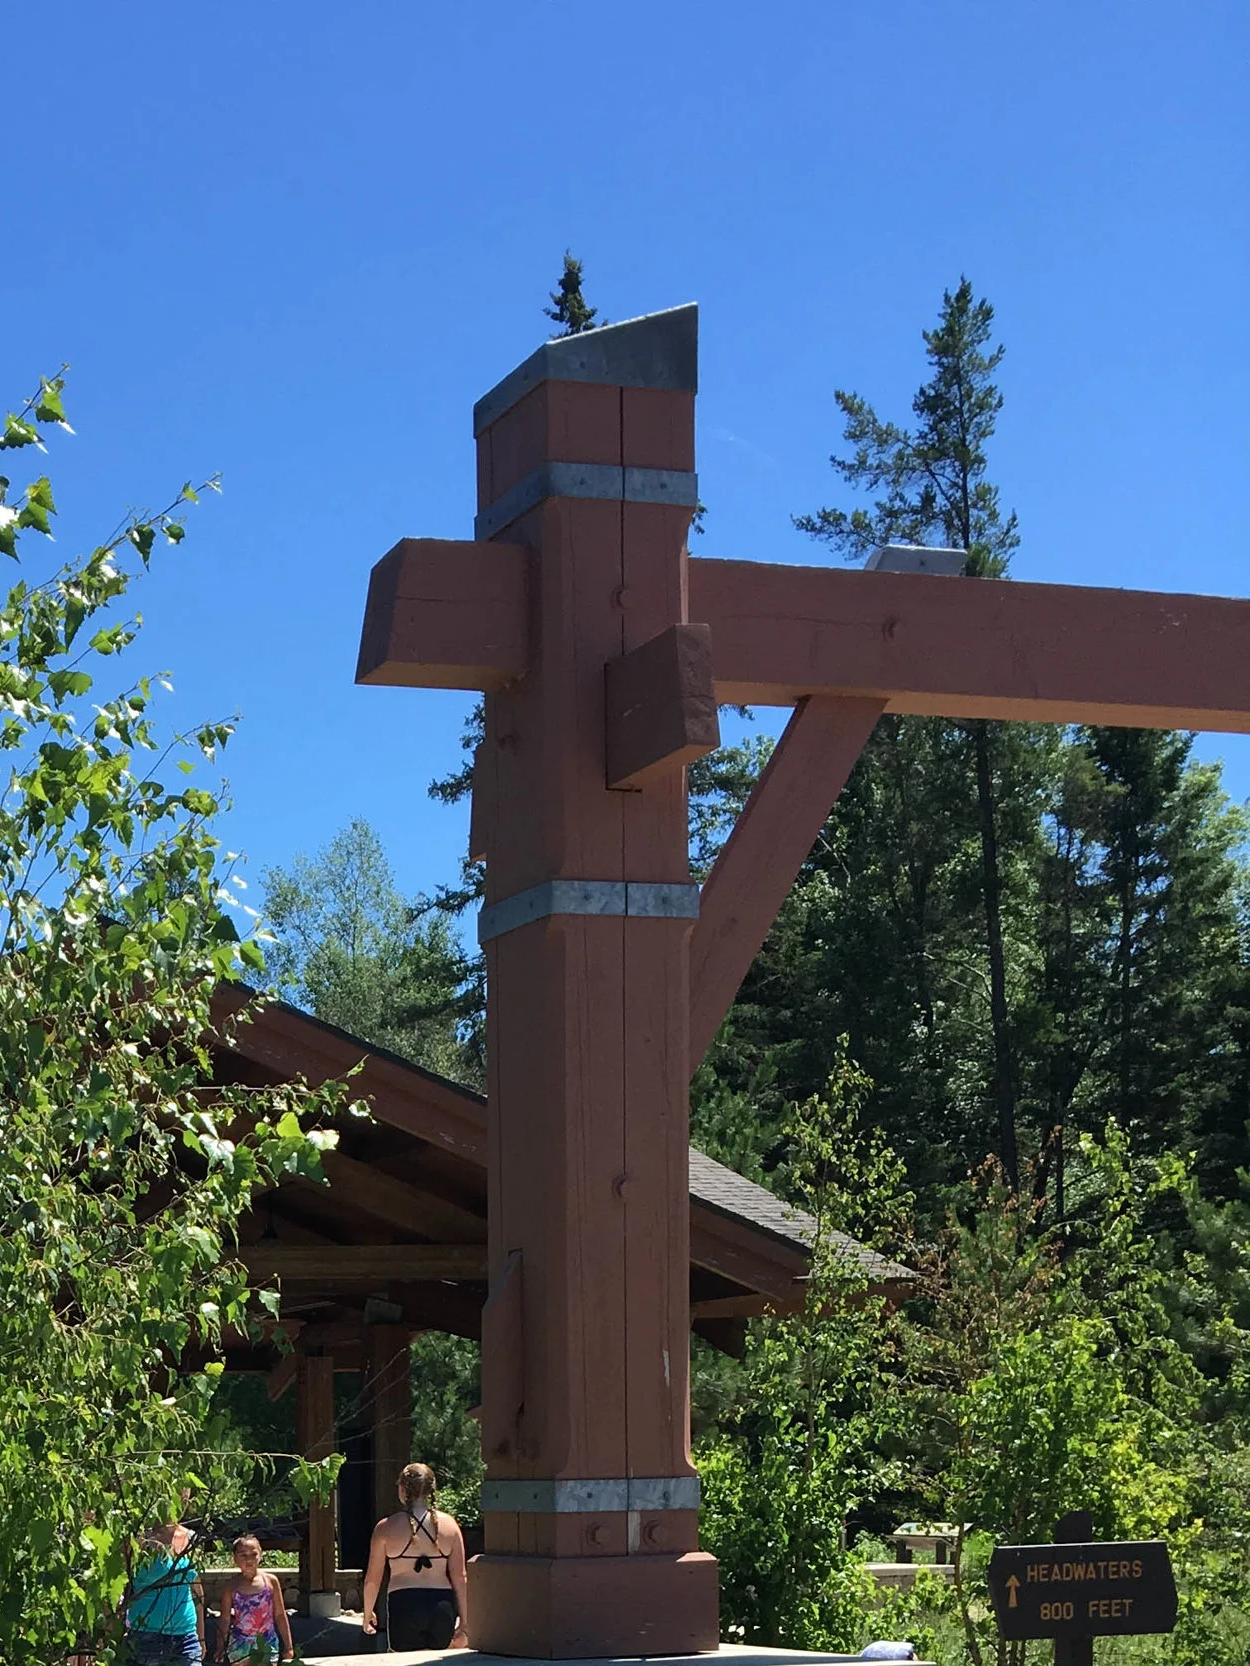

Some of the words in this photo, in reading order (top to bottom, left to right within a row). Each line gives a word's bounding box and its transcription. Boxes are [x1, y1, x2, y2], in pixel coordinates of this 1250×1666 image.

[1026, 1560, 1143, 1583] HEADWATERS
[1040, 1602, 1074, 1620] 800
[1088, 1599, 1133, 1618] FEET
